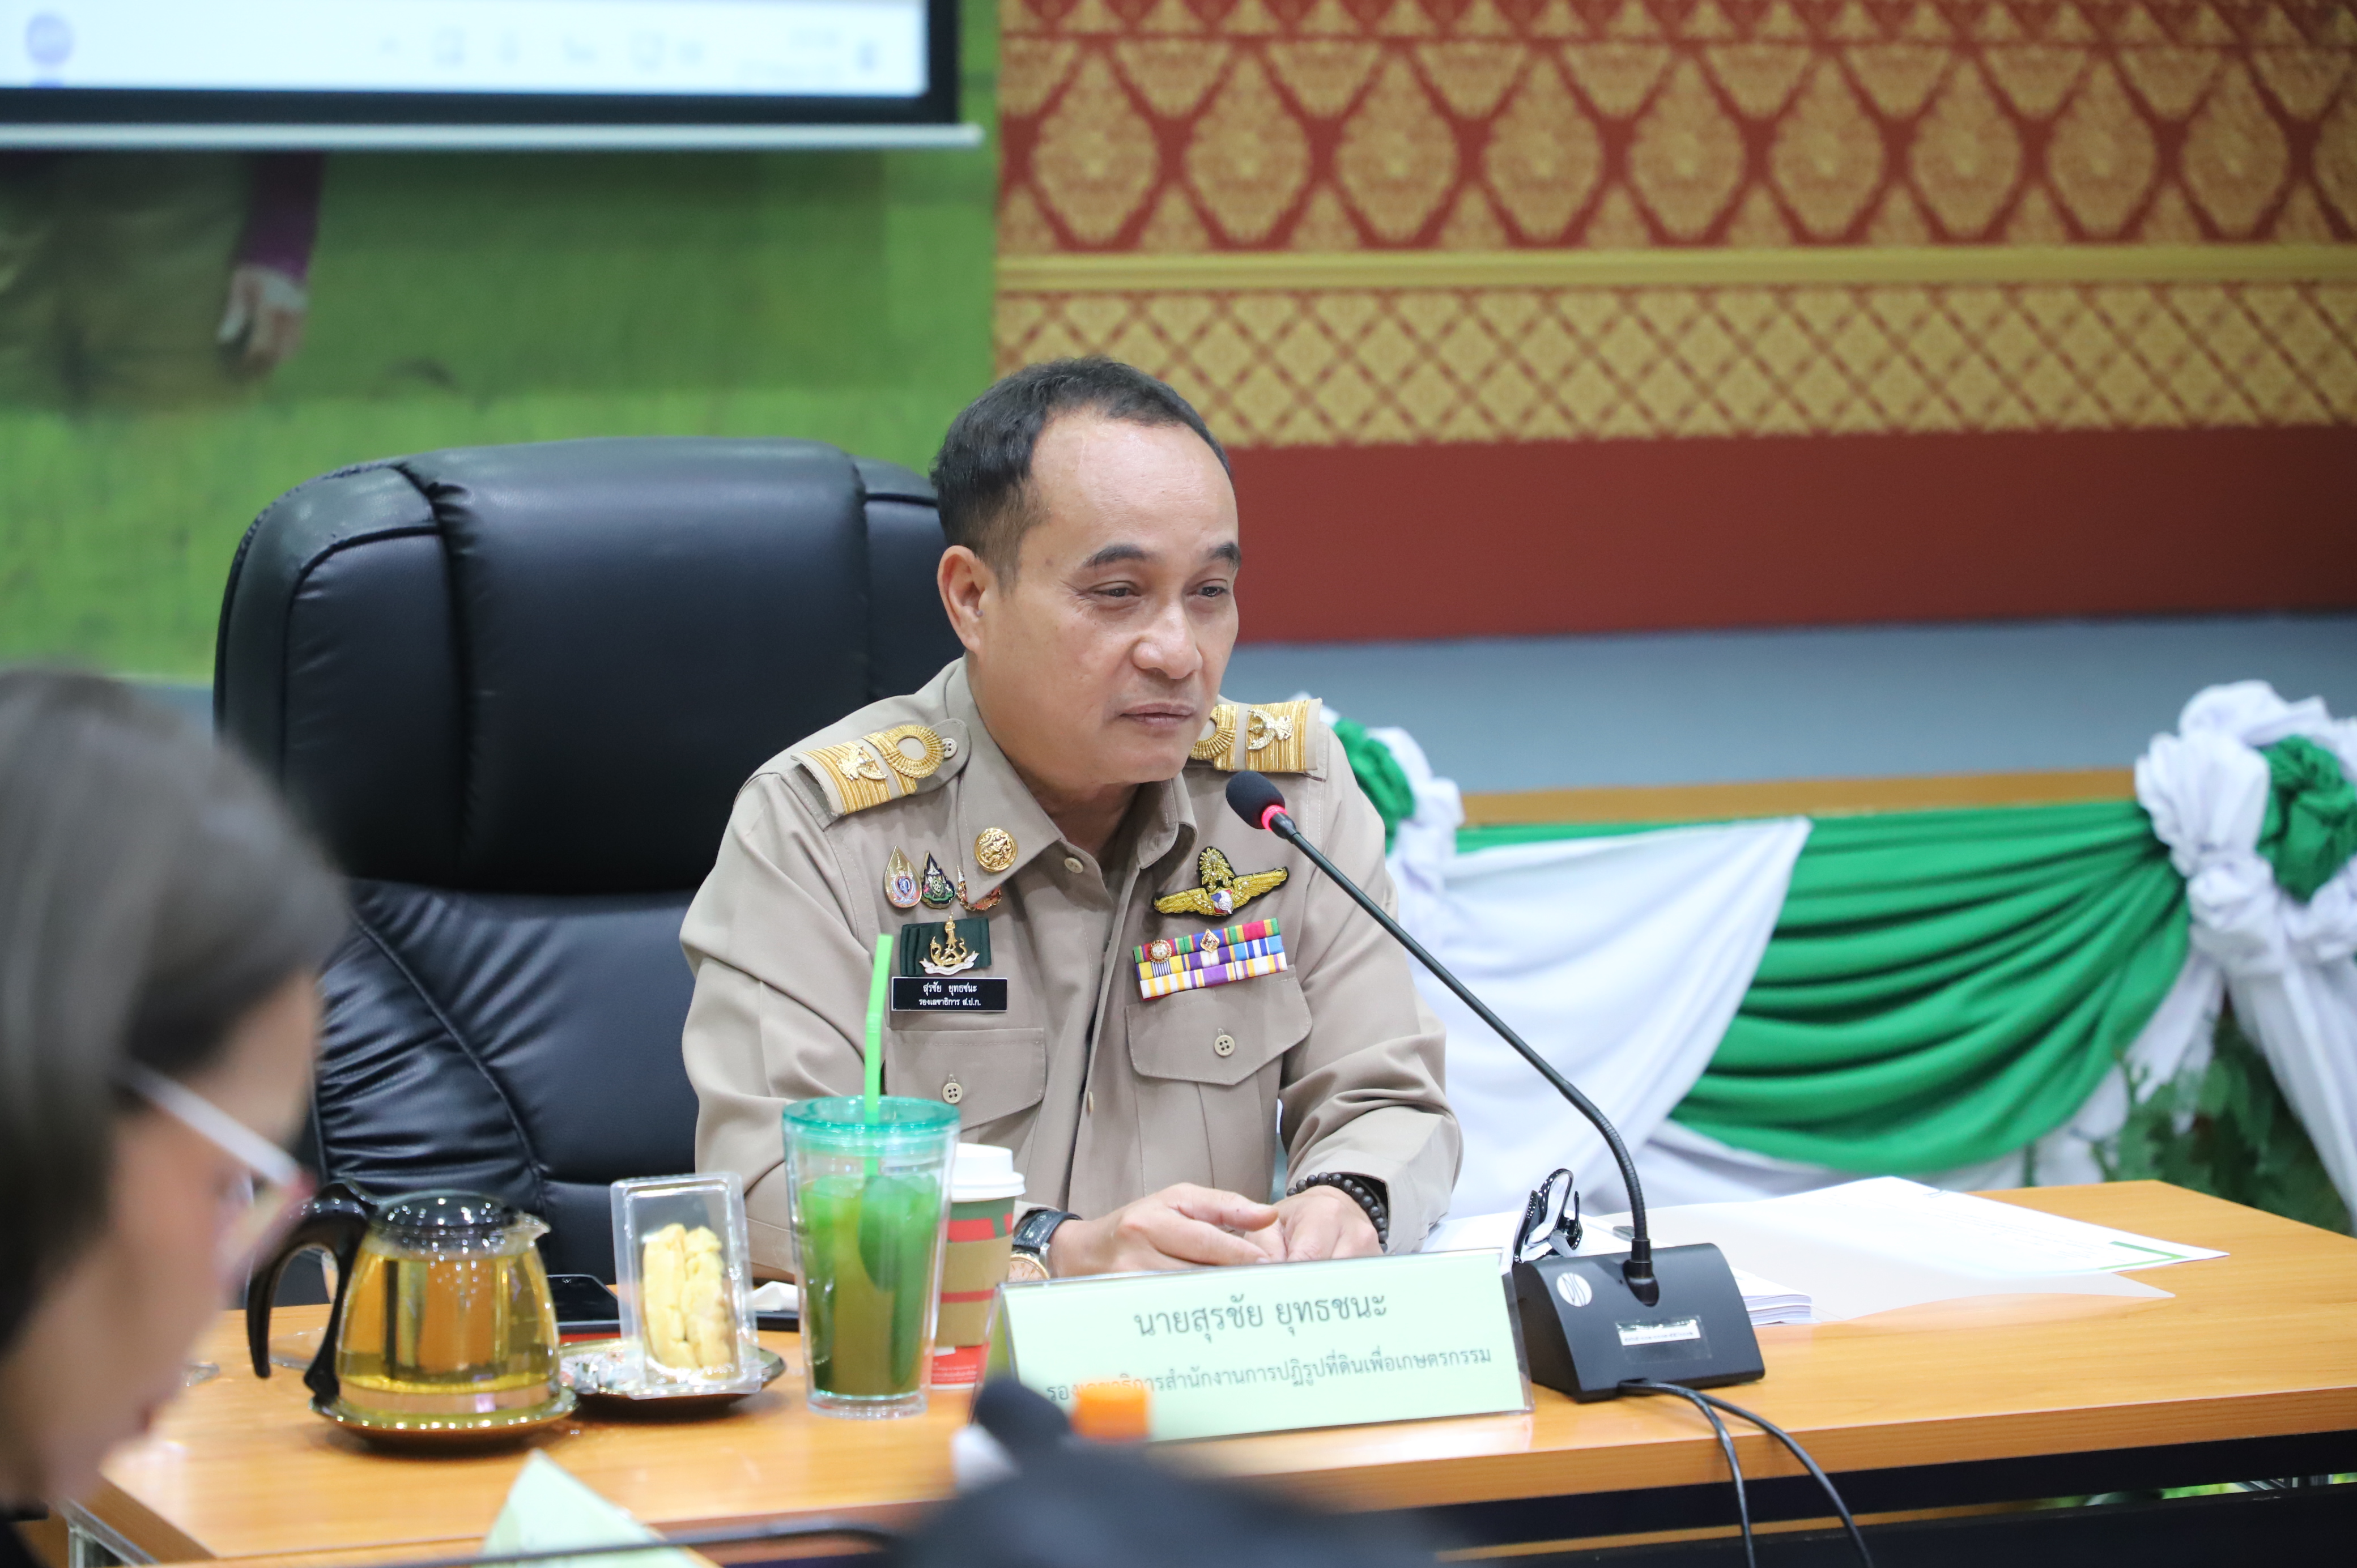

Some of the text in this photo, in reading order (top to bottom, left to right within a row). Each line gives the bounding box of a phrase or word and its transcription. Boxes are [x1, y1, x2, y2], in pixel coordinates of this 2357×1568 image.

[923, 981, 977, 996] สุรชัย ยุทธชนะ
[918, 997, 981, 1006] รองเลขาธิการ ส.ป.ก.
[1134, 1293, 1386, 1343] นายสุรชัย ยุทธชนะ
